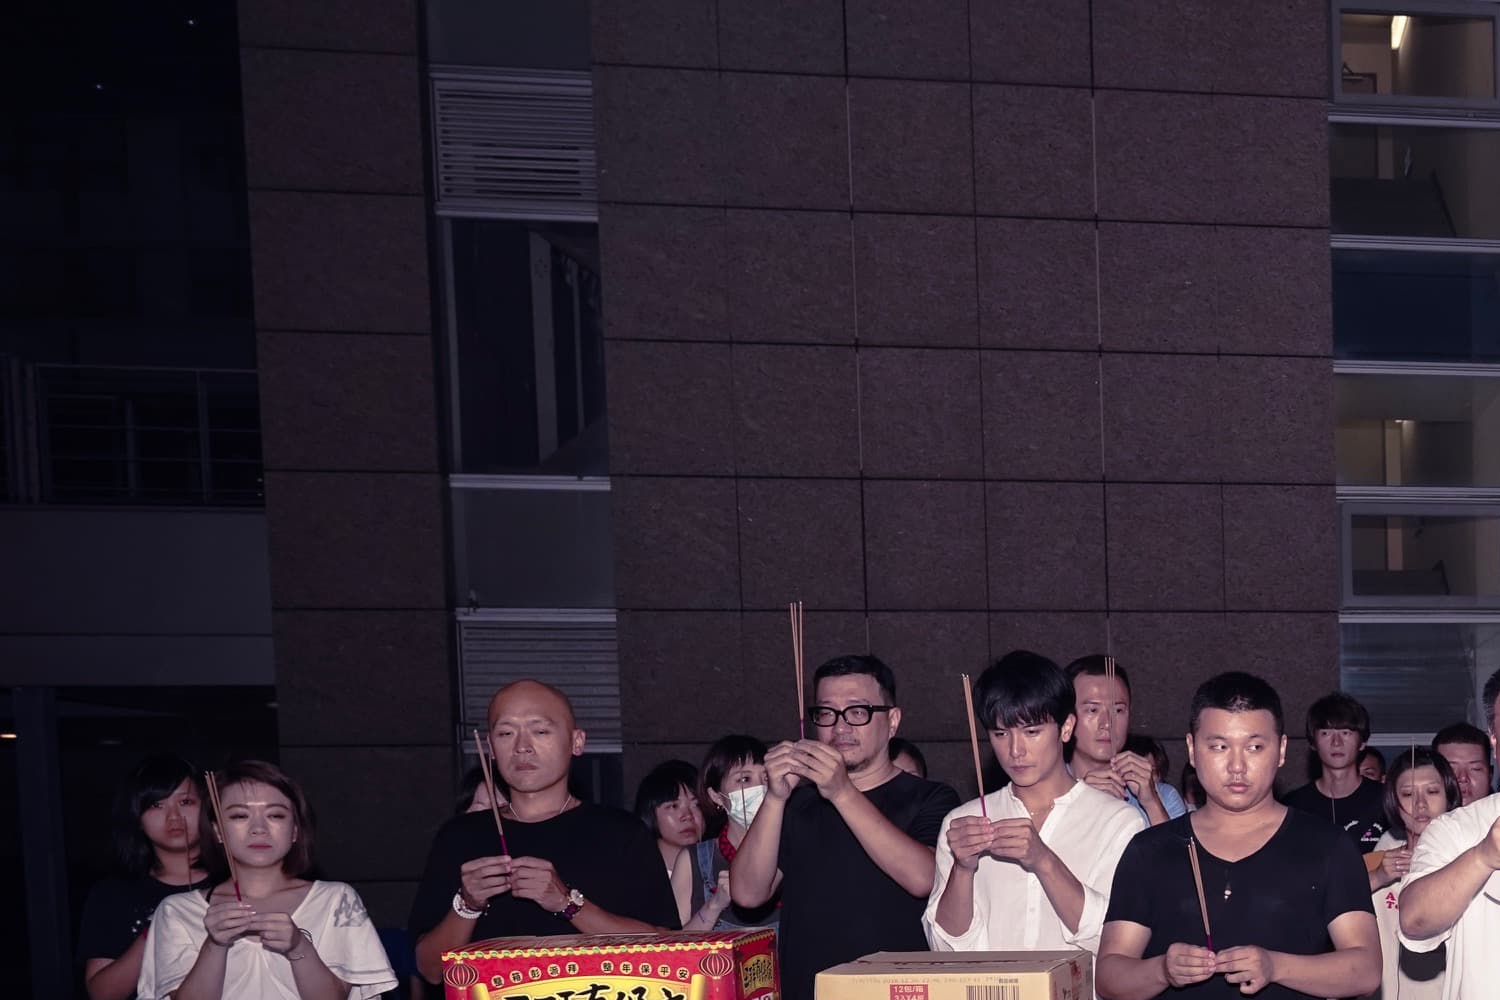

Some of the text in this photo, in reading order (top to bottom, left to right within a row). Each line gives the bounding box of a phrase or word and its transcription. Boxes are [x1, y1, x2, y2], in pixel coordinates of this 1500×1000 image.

[602, 961, 687, 979] 整年保平安
